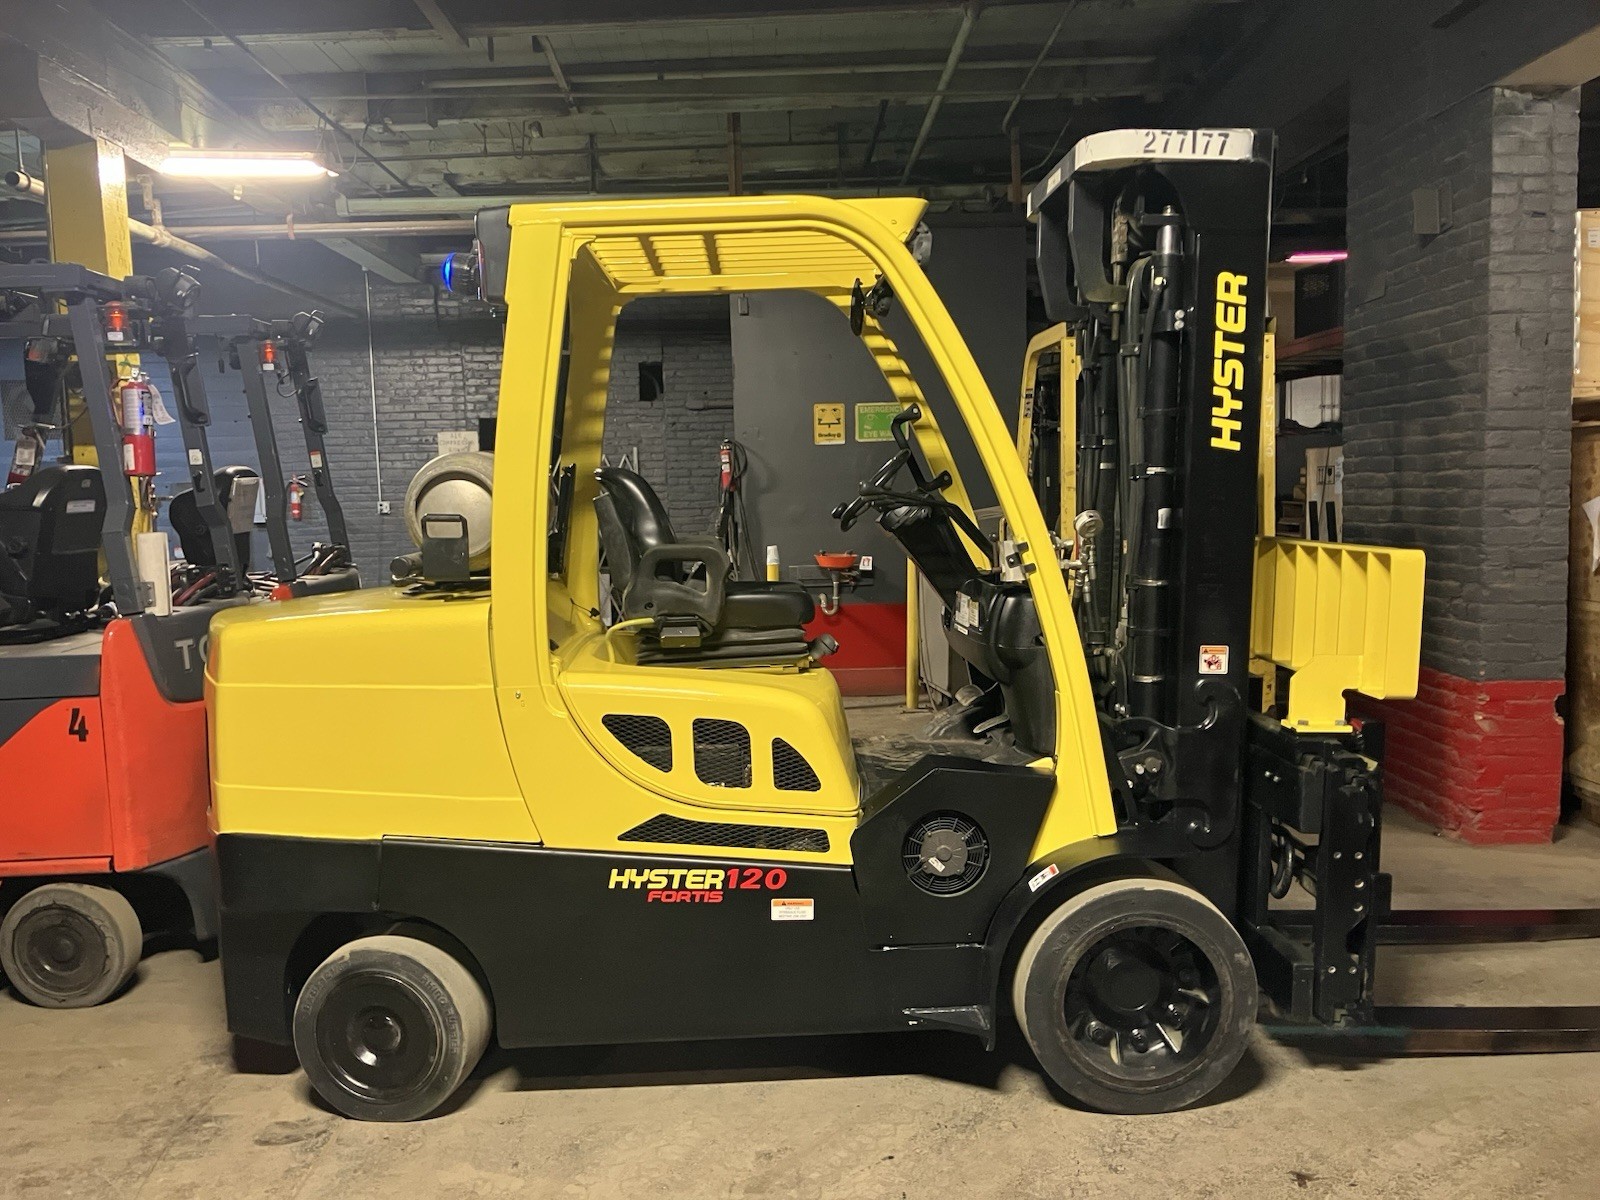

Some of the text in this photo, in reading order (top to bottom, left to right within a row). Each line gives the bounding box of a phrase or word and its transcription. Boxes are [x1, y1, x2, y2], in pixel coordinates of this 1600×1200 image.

[1210, 271, 1248, 451] HYSTER
[860, 405, 901, 414] EMERGENC
[863, 430, 893, 438] EYE WA
[69, 708, 89, 742] 4
[608, 868, 788, 890] HYSTER 120
[647, 890, 724, 903] FORTIS
